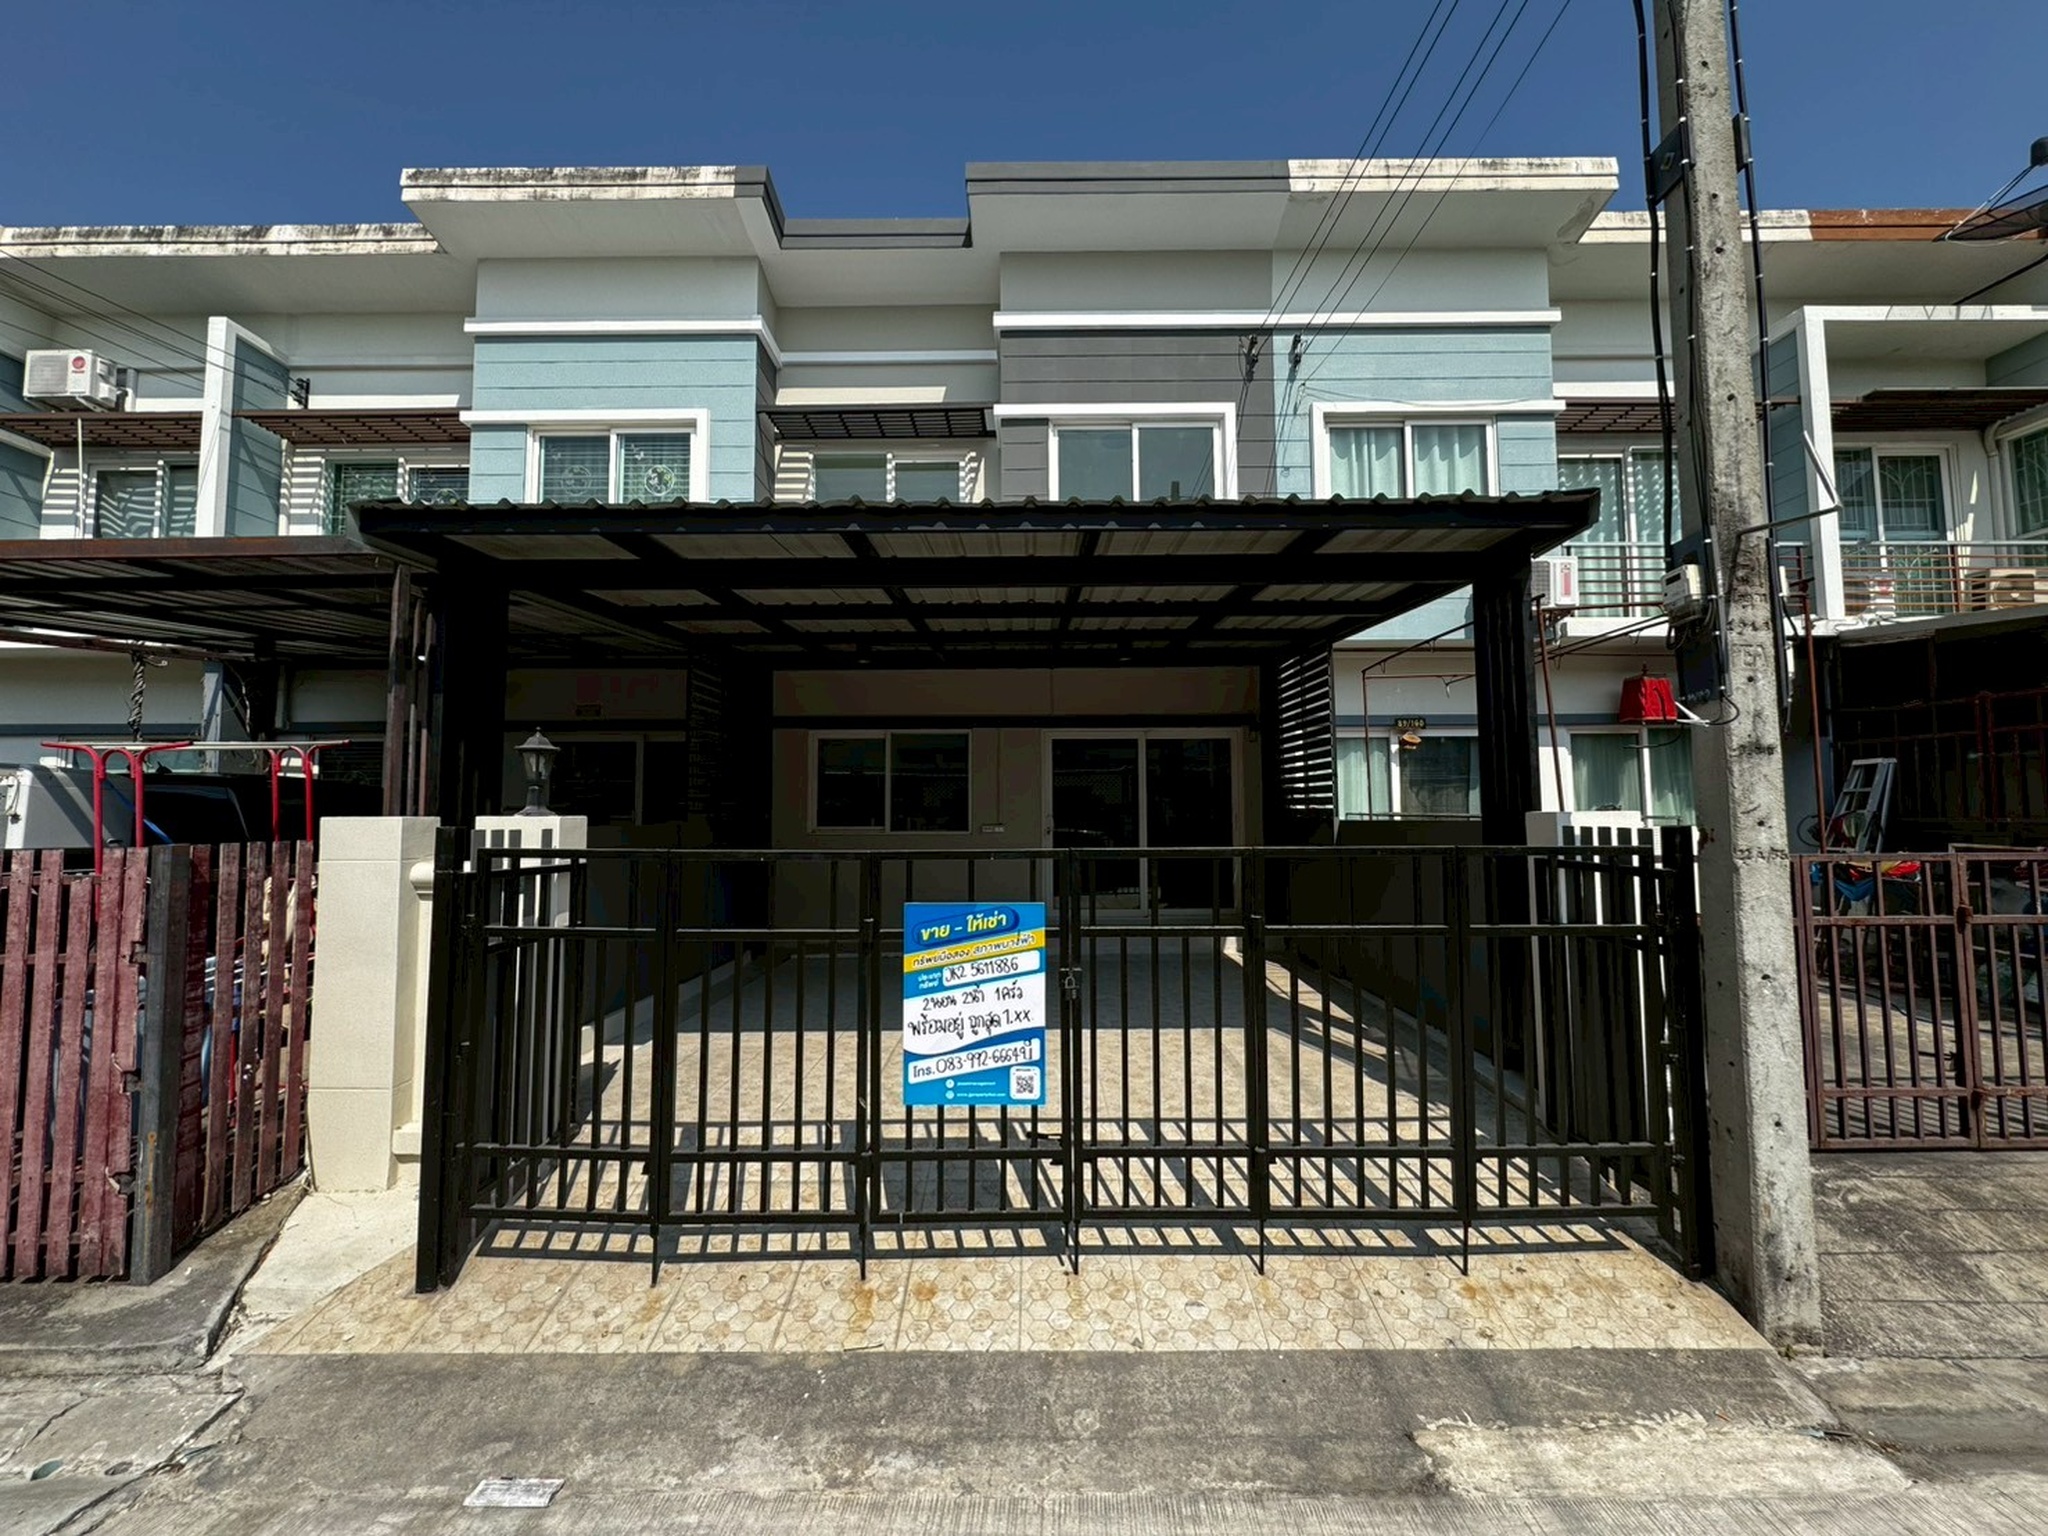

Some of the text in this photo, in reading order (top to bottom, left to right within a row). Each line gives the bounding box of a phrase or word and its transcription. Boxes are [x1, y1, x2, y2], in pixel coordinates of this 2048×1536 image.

[921, 924, 950, 940] ขาย
[966, 910, 1007, 933] ให้เช่า
[908, 1012, 965, 1040] พร้อมอยู่
[913, 1065, 936, 1078] โทร.
